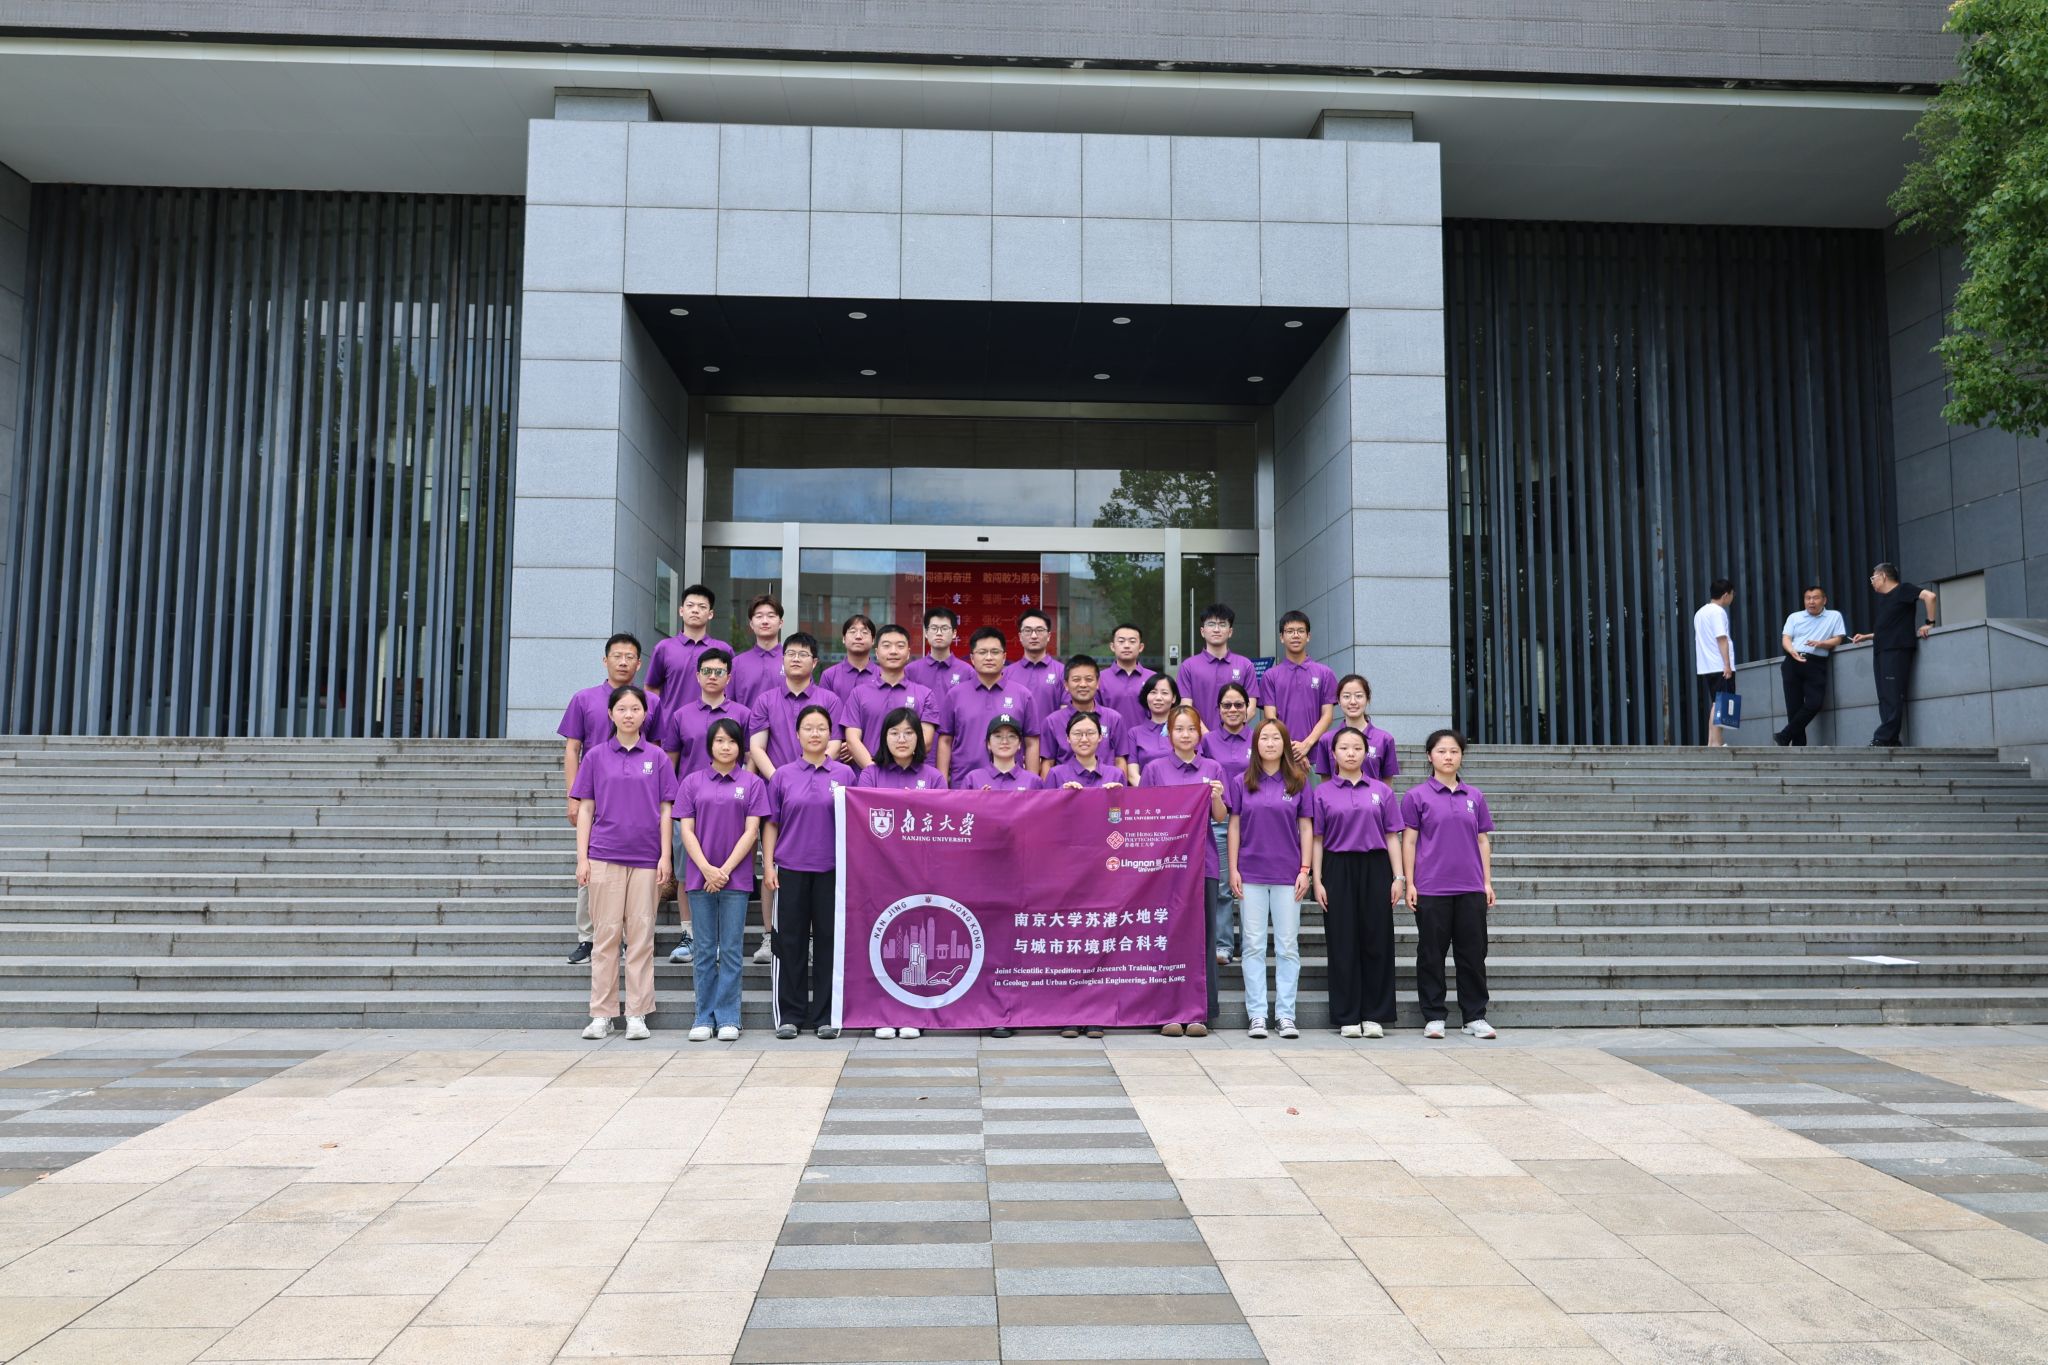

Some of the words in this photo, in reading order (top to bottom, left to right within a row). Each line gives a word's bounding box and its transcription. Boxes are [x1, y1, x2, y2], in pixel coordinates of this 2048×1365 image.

[1121, 859, 1155, 869] Lingnan
[1138, 865, 1165, 873] University
[873, 919, 887, 939] NAN
[888, 901, 908, 917] JING
[949, 902, 973, 922] HONG
[970, 922, 982, 949] KONG
[1014, 908, 1169, 928] 南京大学苏港大地学
[1014, 935, 1168, 955] 与城市环境联合科考
[1045, 967, 1081, 976] Expedition
[1097, 964, 1127, 973] Research
[1128, 964, 1157, 972] Training
[1158, 963, 1186, 971] Program
[1002, 979, 1029, 988] Geology
[1046, 978, 1067, 986] Urban
[1069, 978, 1104, 986] Geological
[1105, 976, 1147, 985] Engineering,
[1149, 976, 1167, 984] Hong
